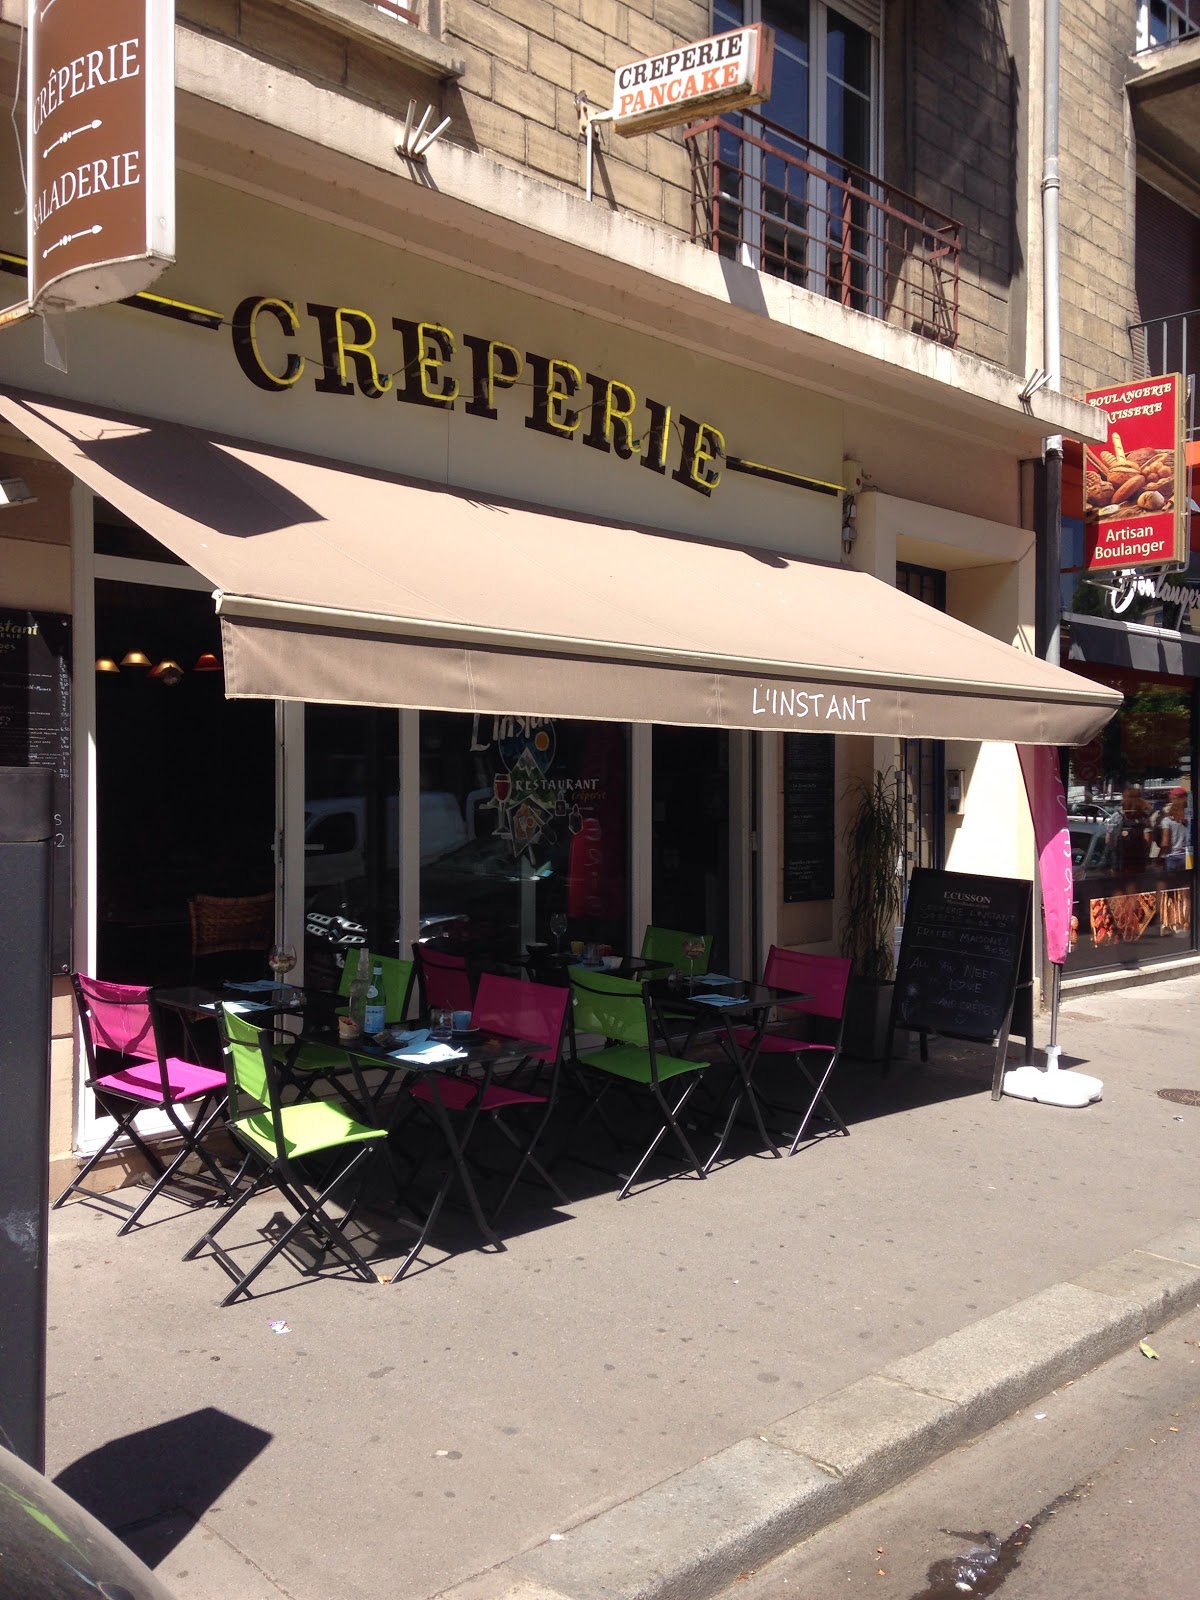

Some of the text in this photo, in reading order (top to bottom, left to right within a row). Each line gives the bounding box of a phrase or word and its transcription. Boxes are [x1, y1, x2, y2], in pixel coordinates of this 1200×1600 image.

[618, 33, 743, 90] CREPERIE
[32, 38, 141, 135] CRÊPERIE
[618, 61, 740, 117] PANCAKE
[231, 295, 726, 498] CREPERIE
[1088, 382, 1173, 407] BOULANGERIE
[1106, 402, 1163, 424] ATISSERIE
[1105, 525, 1154, 542] Artisan
[1094, 539, 1165, 560] Boulanger
[752, 687, 872, 721] L'INSTANT
[515, 778, 600, 792] RESTAURANT
[943, 891, 992, 904] ECUSSON
